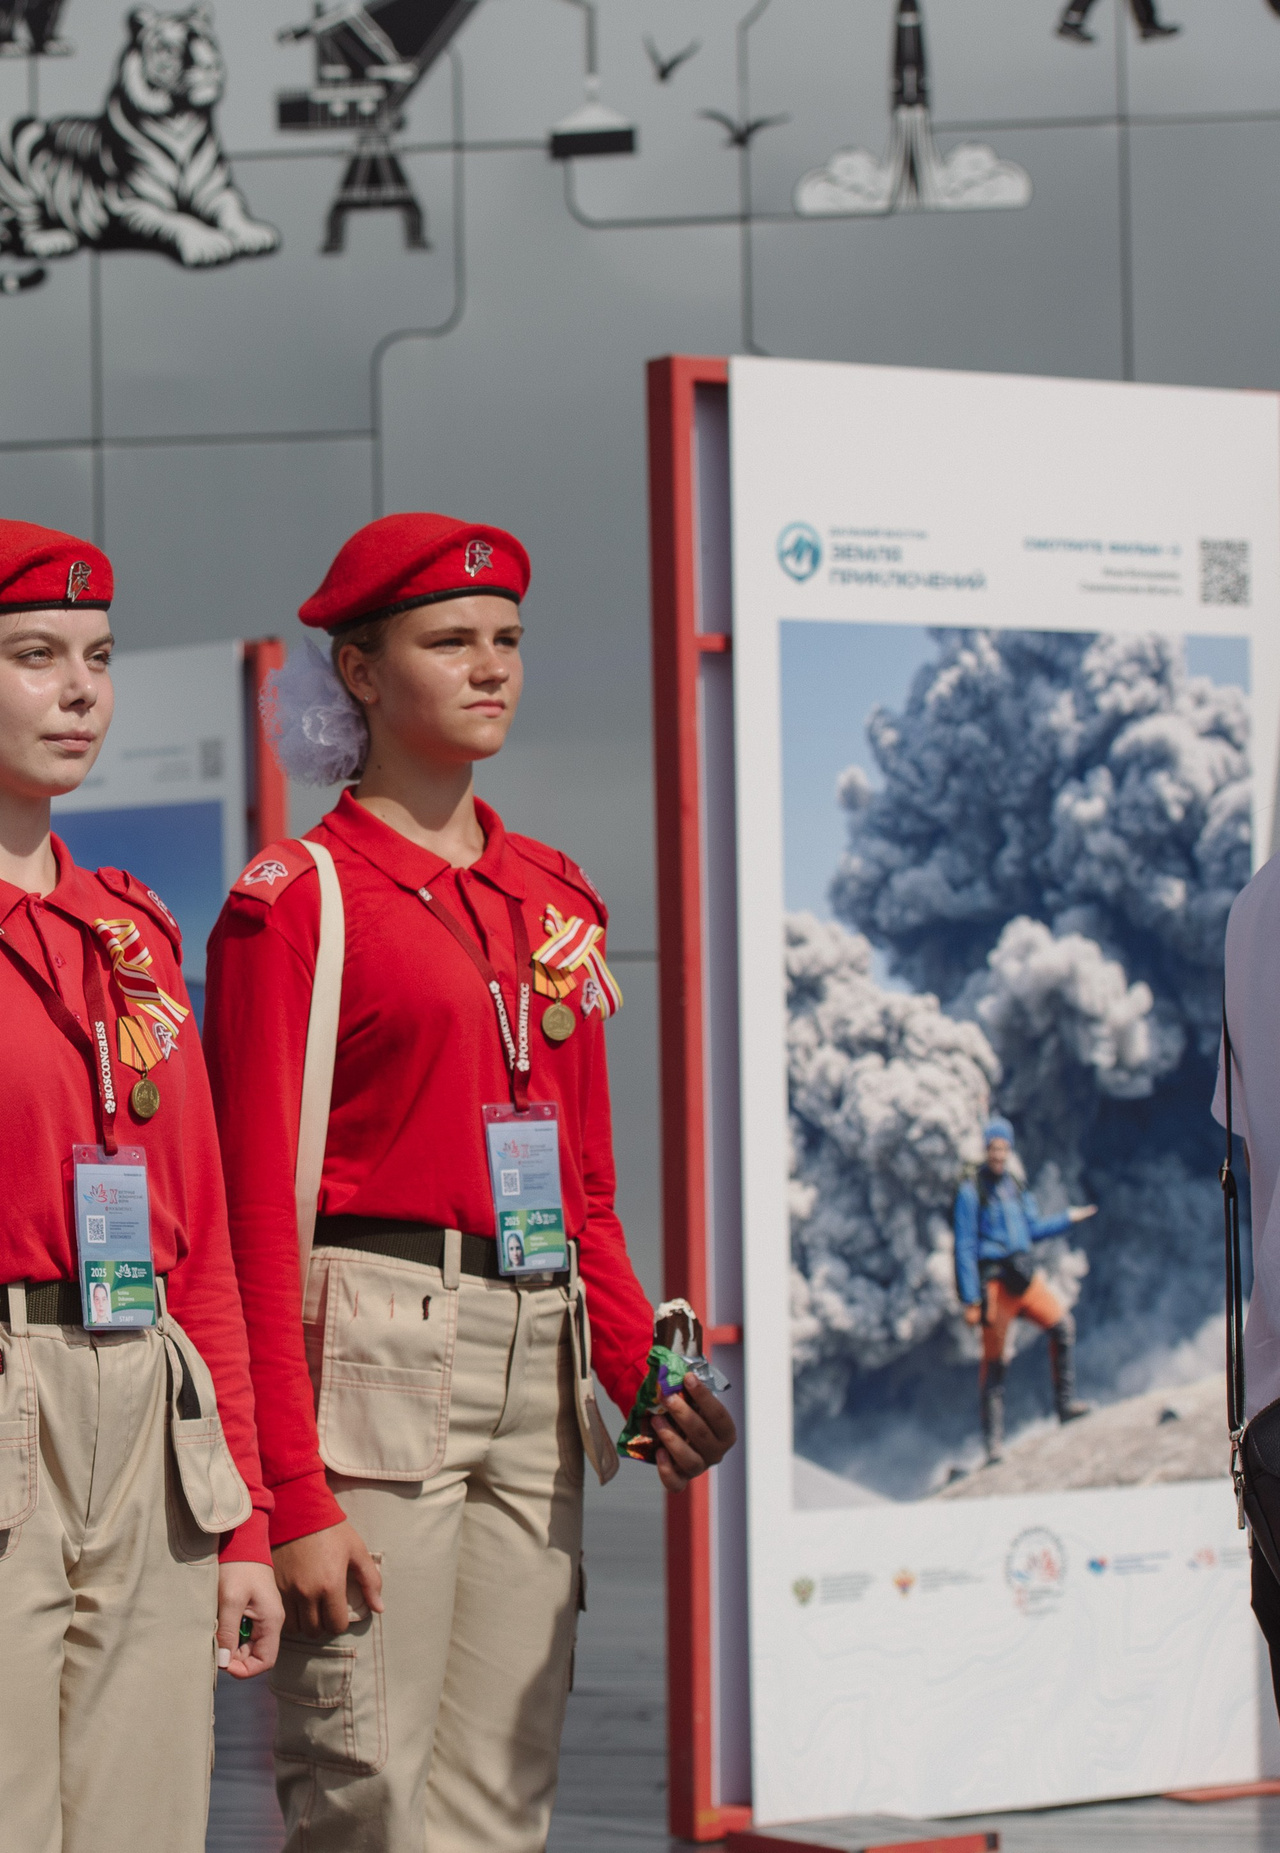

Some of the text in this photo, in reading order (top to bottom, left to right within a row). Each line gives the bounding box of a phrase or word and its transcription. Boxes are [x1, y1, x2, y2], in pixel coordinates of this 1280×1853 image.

[518, 982, 530, 1059] РОСКОНГРЕСС
[95, 1021, 115, 1100] ROSCONGRESS
[91, 1267, 107, 1278] 2025
[119, 1315, 134, 1323] STAFF
